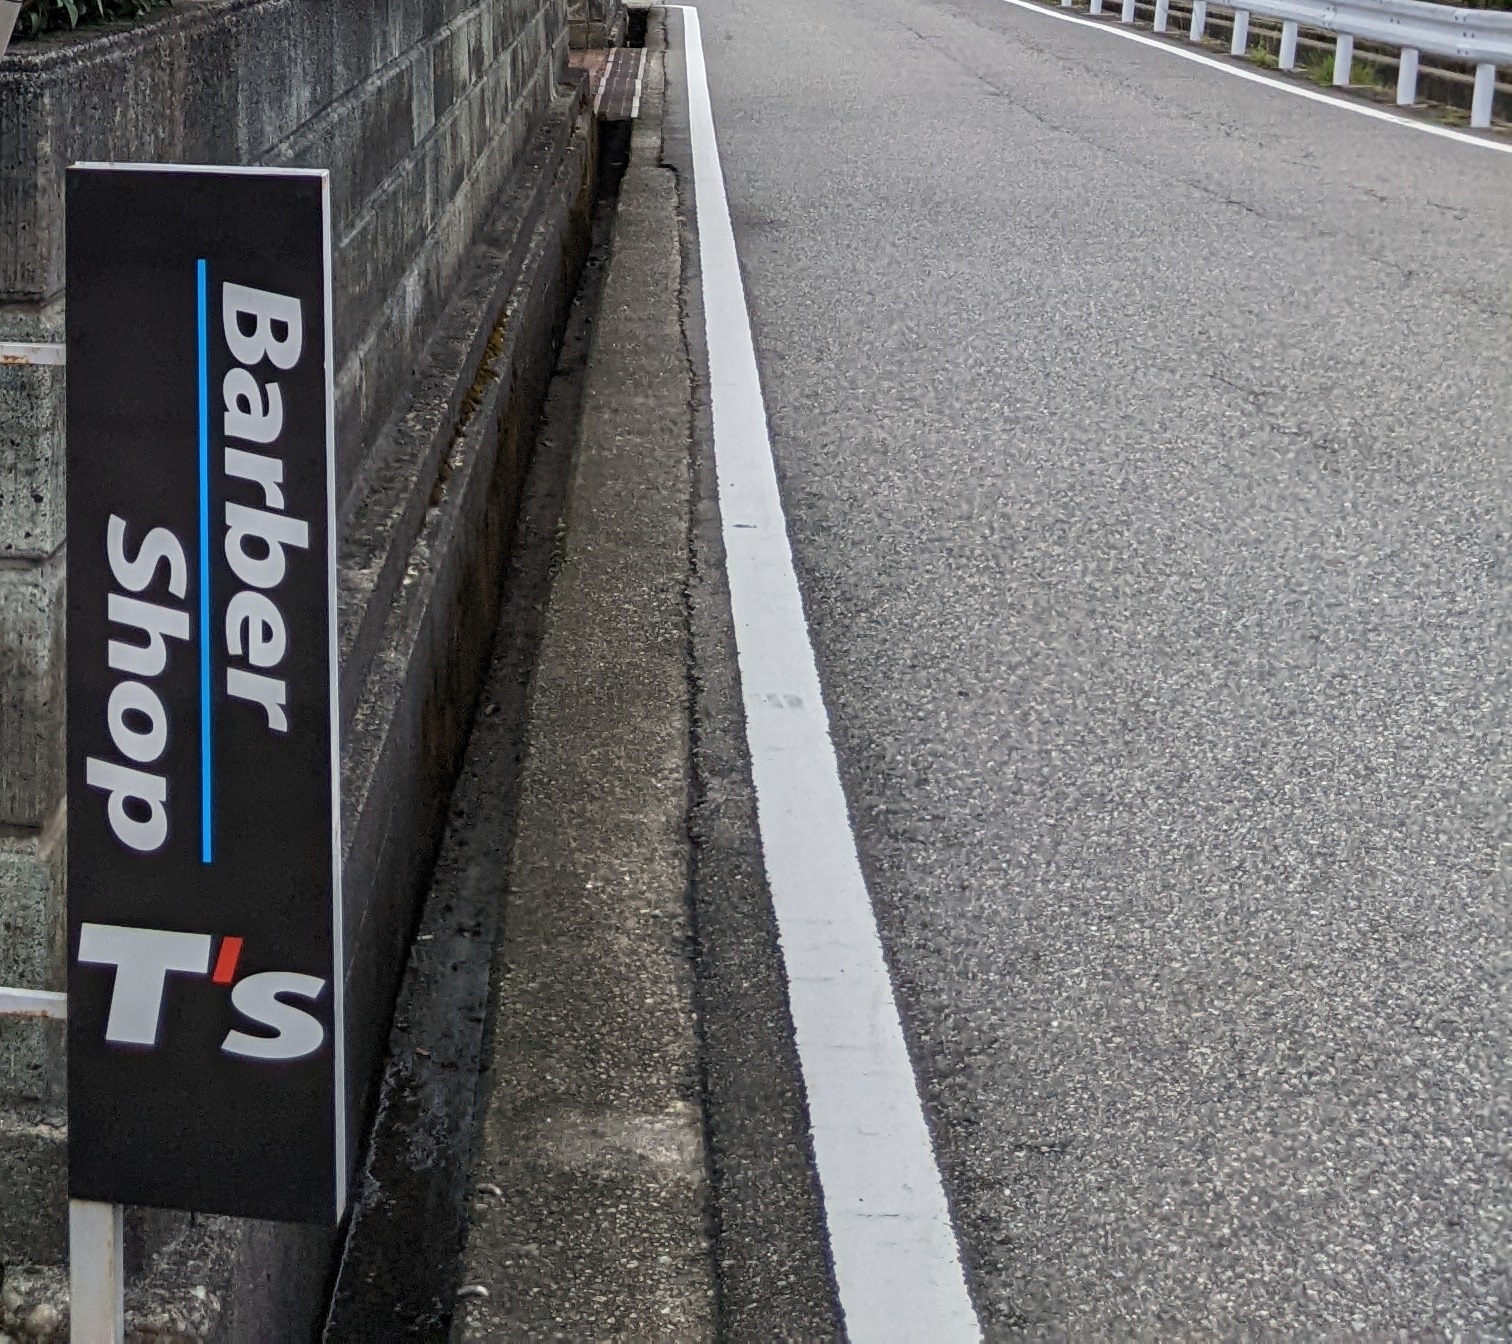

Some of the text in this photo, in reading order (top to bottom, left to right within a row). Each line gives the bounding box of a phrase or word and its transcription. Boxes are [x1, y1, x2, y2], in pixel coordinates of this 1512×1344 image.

[221, 280, 309, 734] Barber
[85, 512, 190, 853] Shop
[76, 921, 327, 1060] T's
